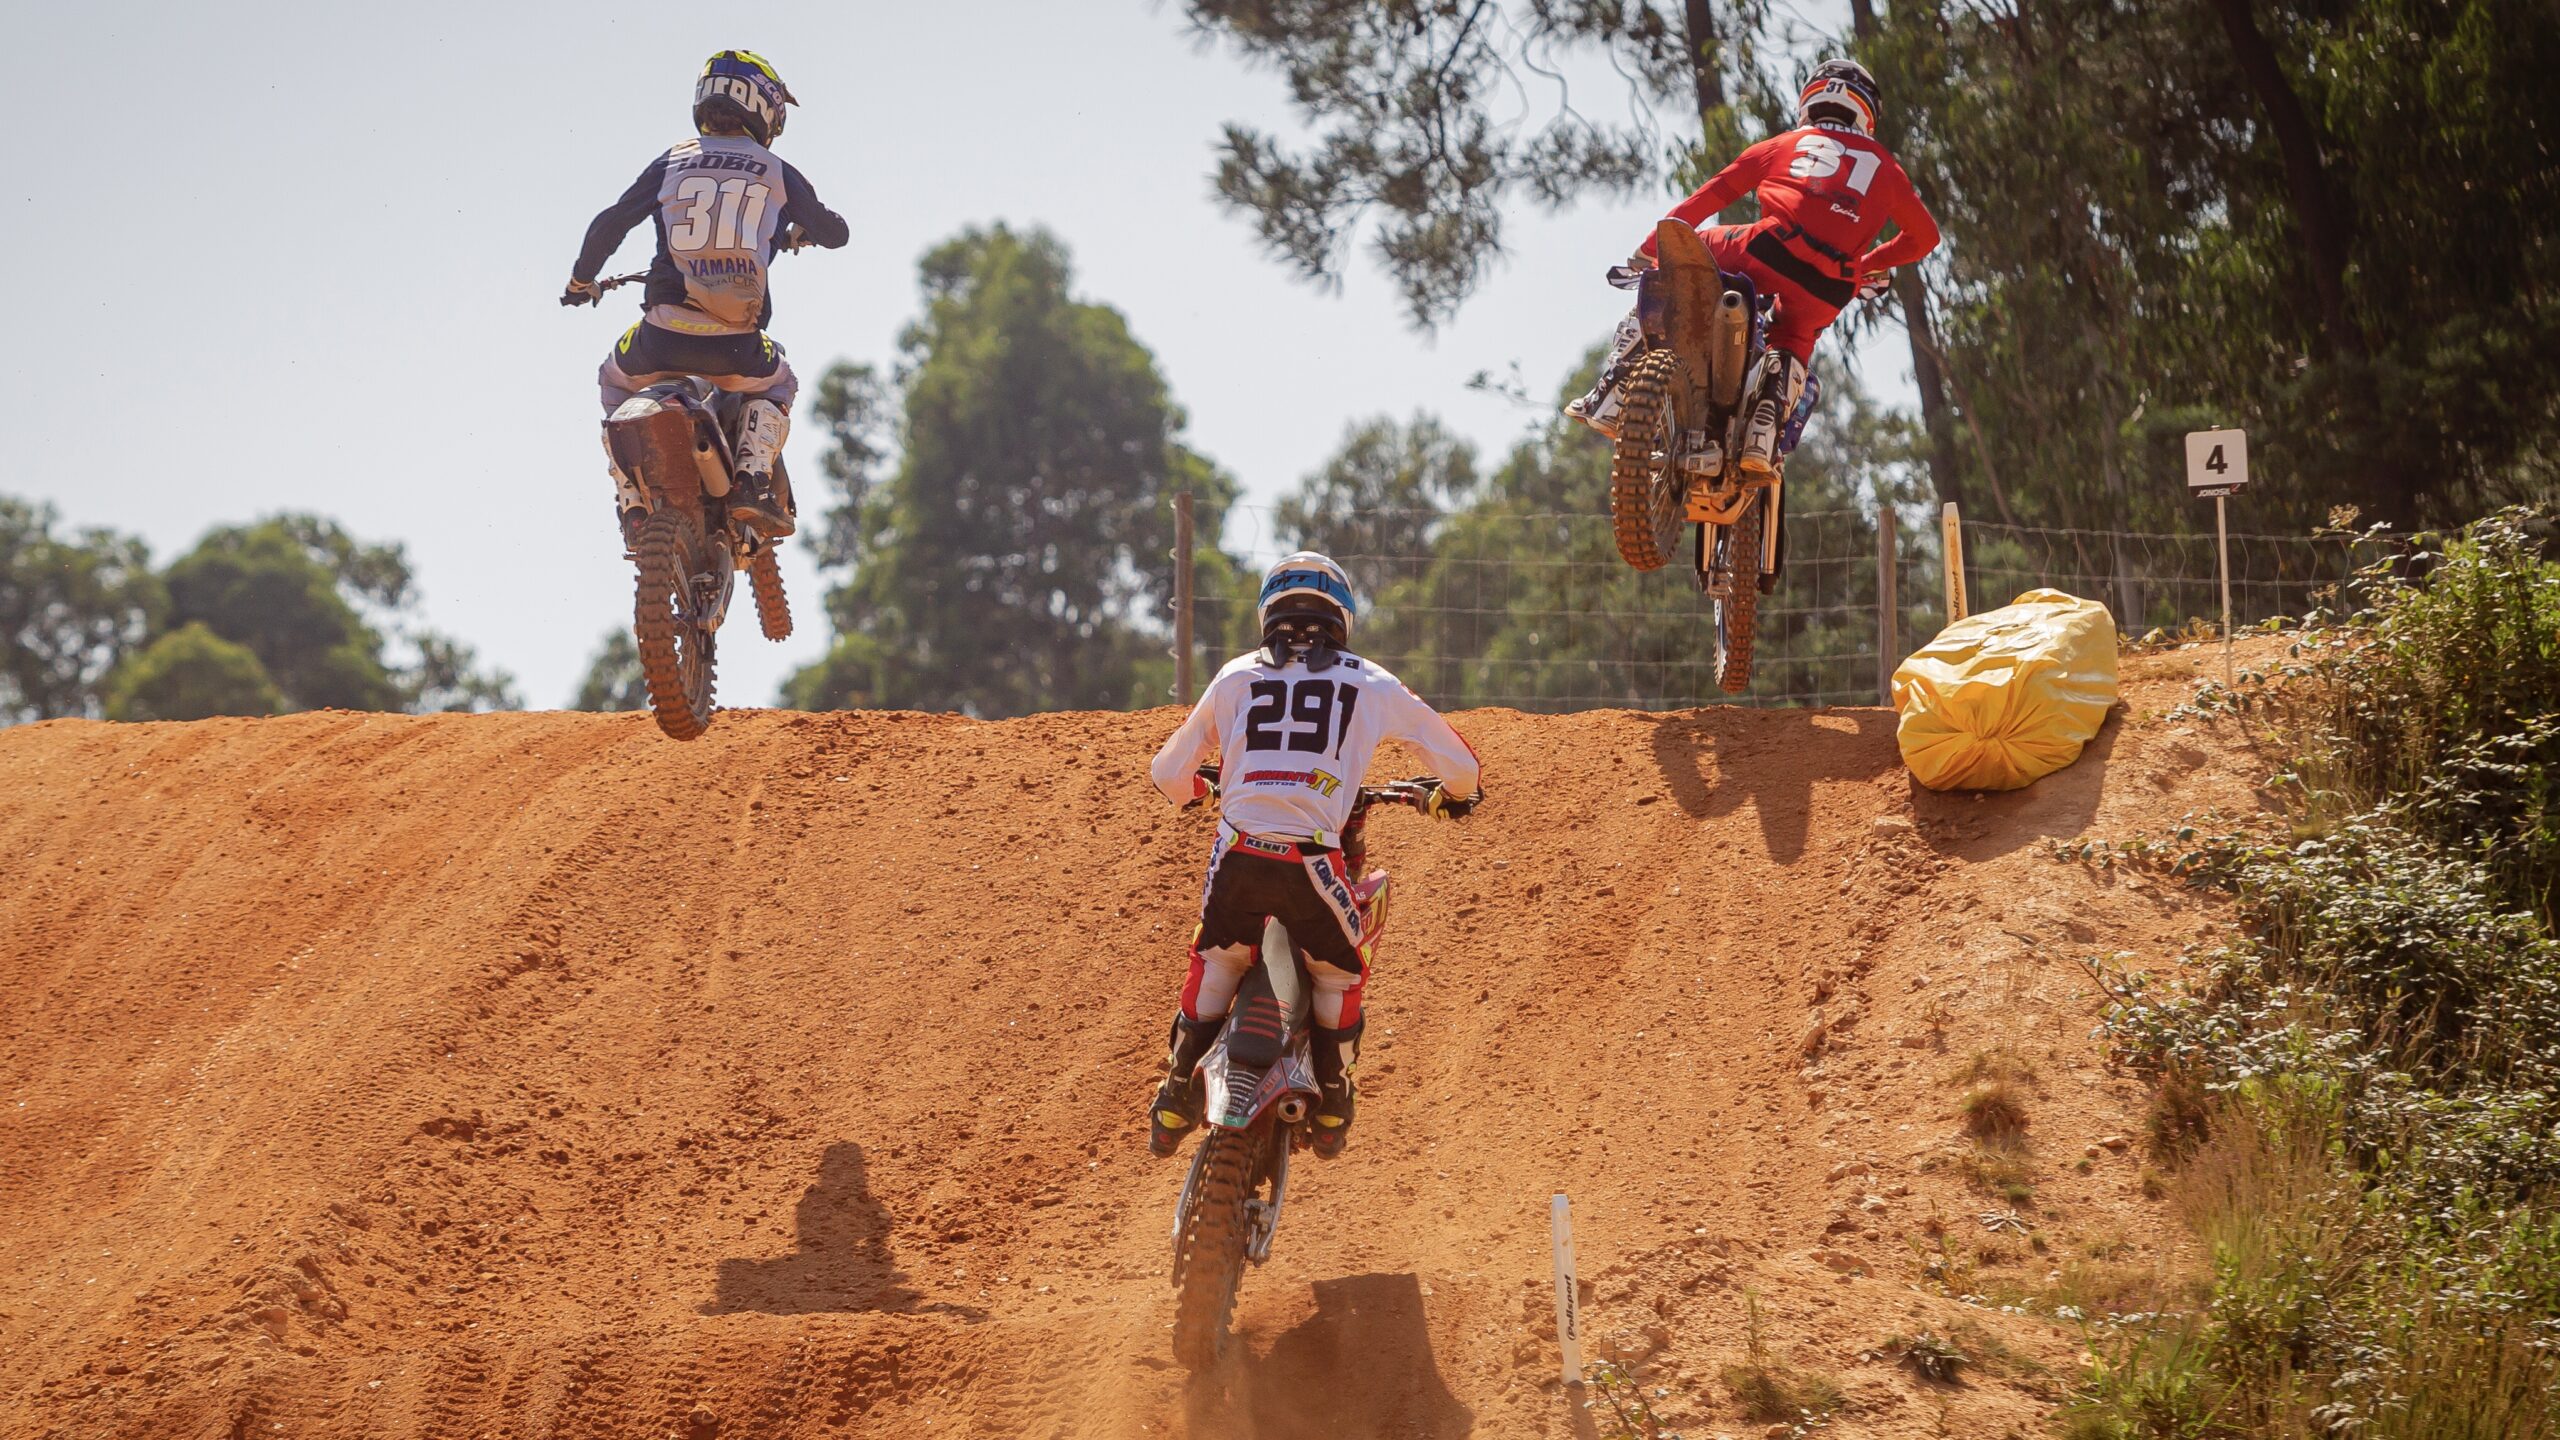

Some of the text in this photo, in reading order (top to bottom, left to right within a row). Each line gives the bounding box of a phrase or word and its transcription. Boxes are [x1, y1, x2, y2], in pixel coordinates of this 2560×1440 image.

[1826, 81, 1844, 93] 31
[1789, 135, 1882, 197] 31
[670, 175, 771, 251] 311
[1829, 203, 1860, 222] Racing
[688, 258, 758, 276] YAMAHA
[2206, 445, 2228, 474] 4
[1245, 679, 1359, 761] 291
[1246, 837, 1289, 853] KENNY
